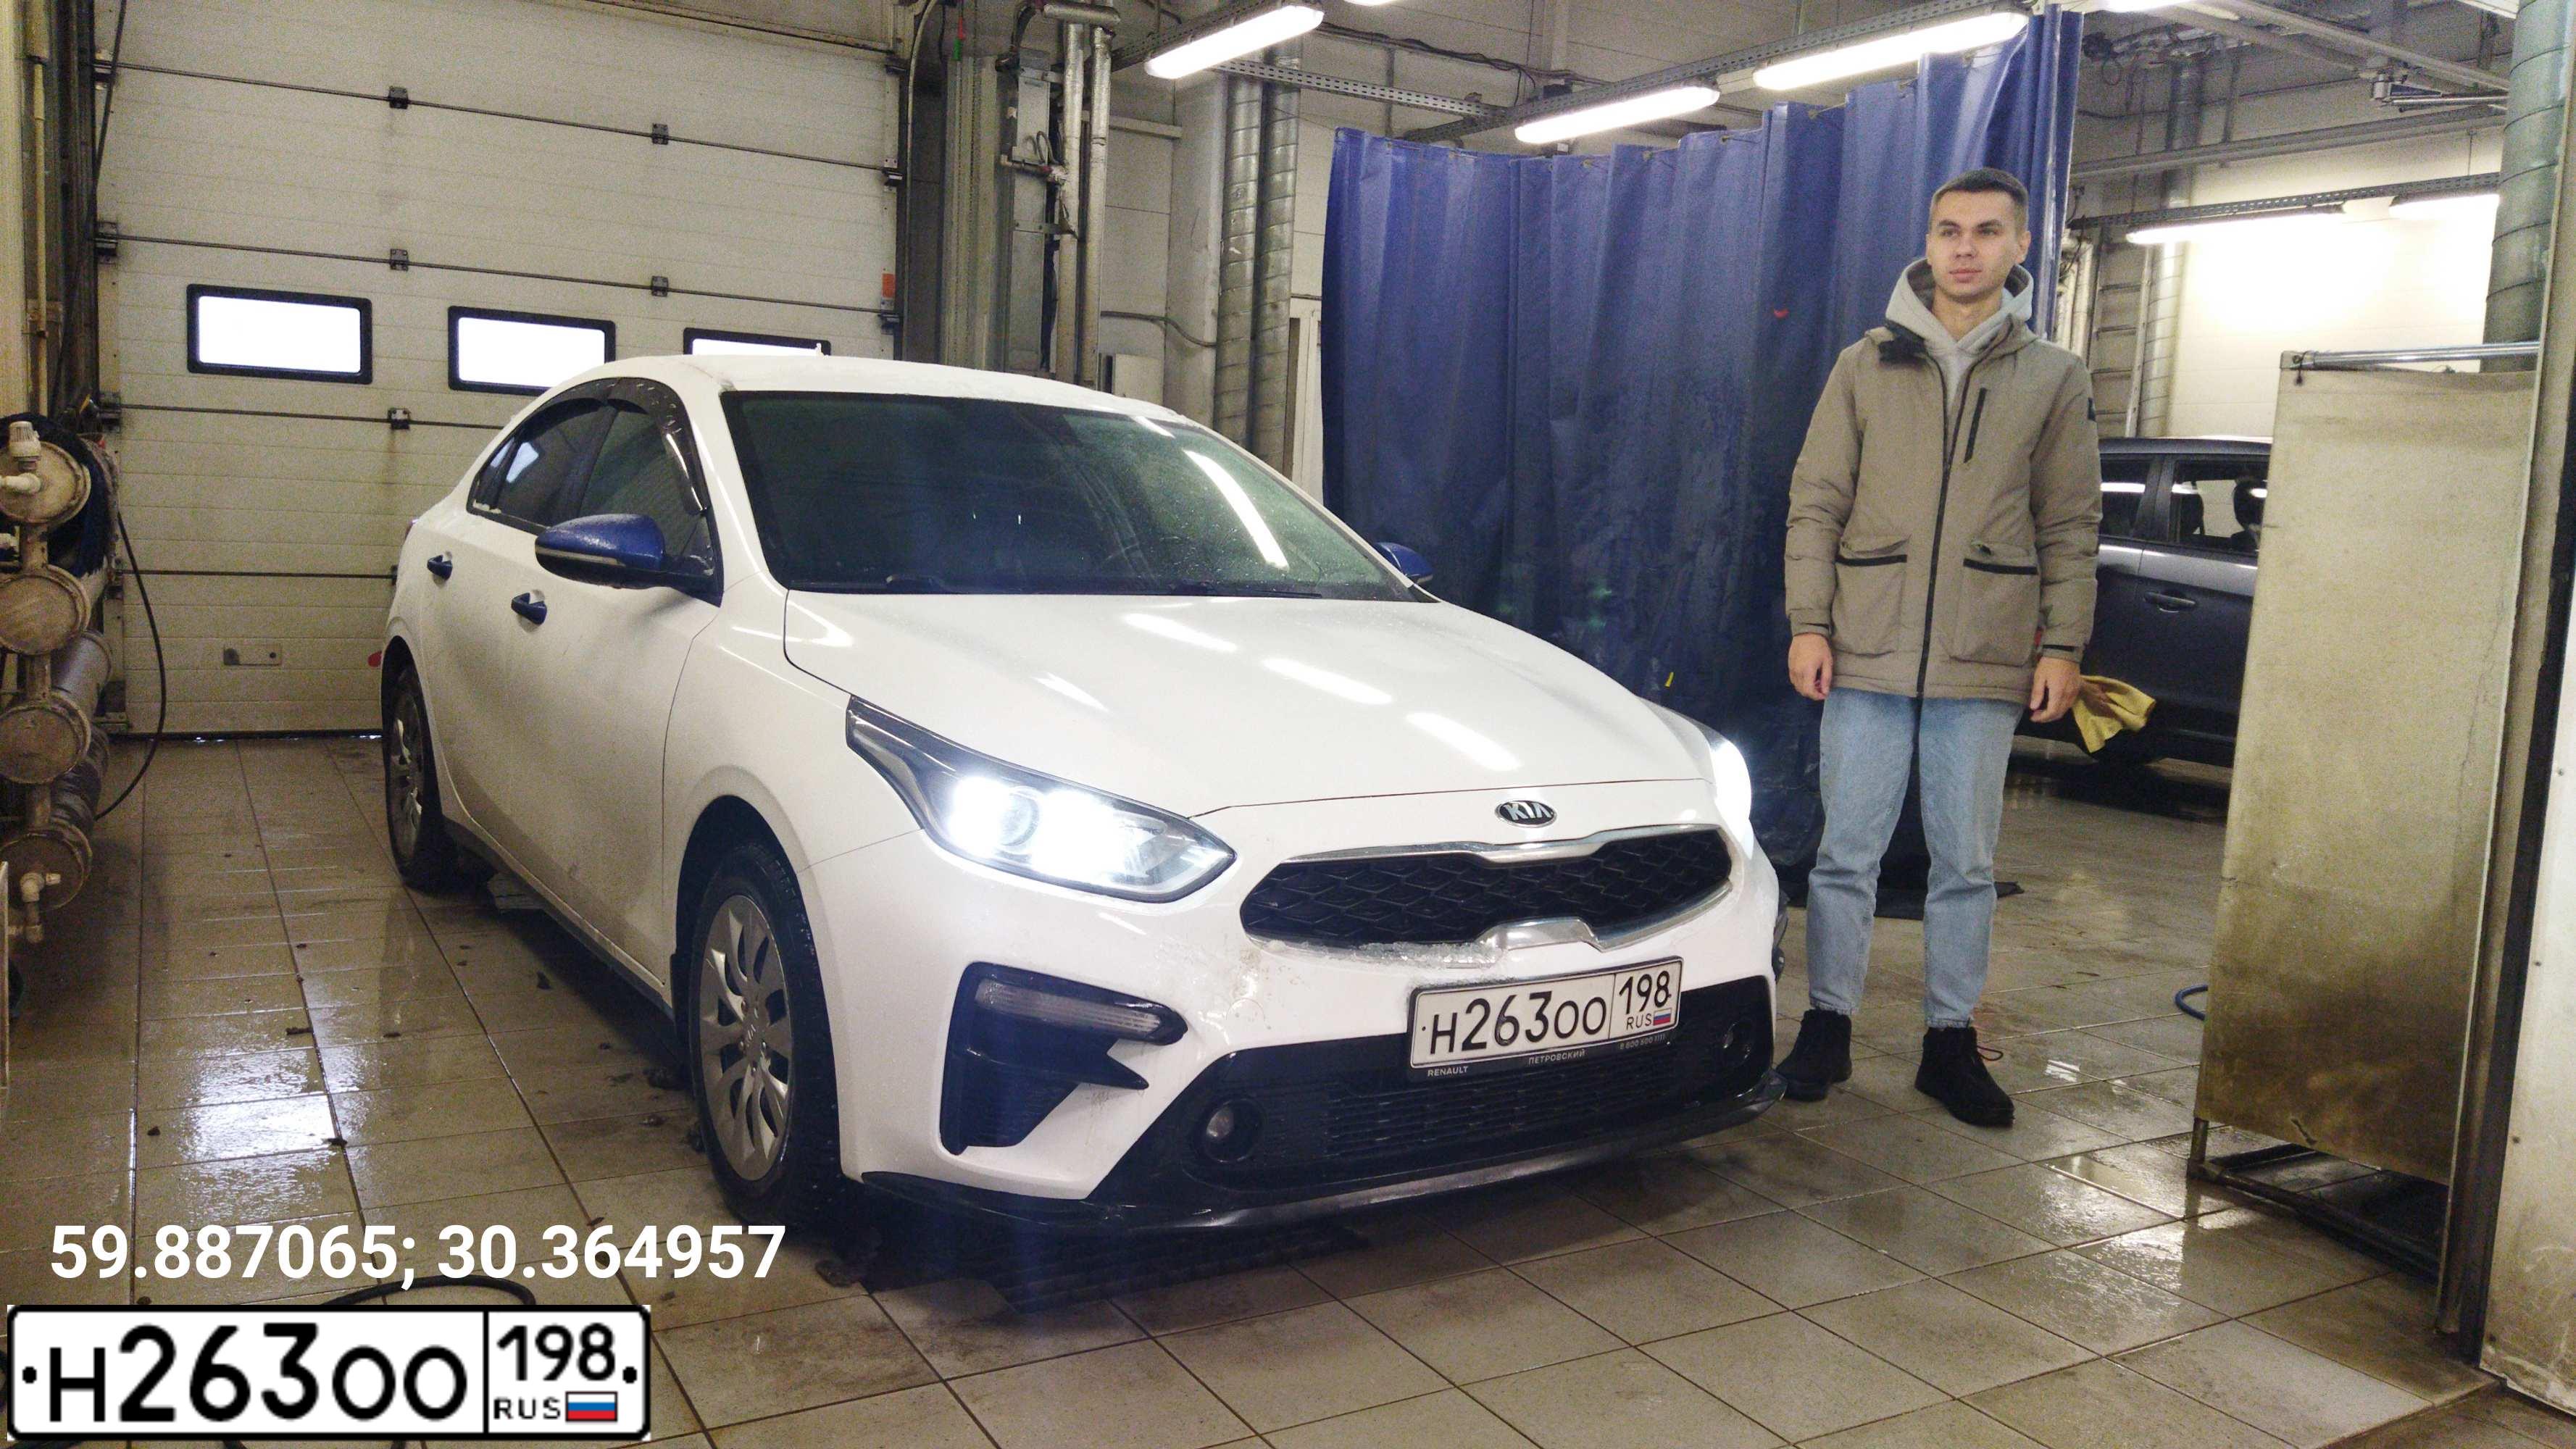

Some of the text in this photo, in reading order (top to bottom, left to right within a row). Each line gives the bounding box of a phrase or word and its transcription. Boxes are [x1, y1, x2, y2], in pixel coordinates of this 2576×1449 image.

[1503, 801, 1552, 820] KIA
[1619, 970, 1670, 1015] 198
[1626, 1013, 1652, 1030] RUS
[1528, 1048, 1585, 1065] ПЕТРОВСКИЙ
[1427, 1066, 1468, 1077] RENAULT
